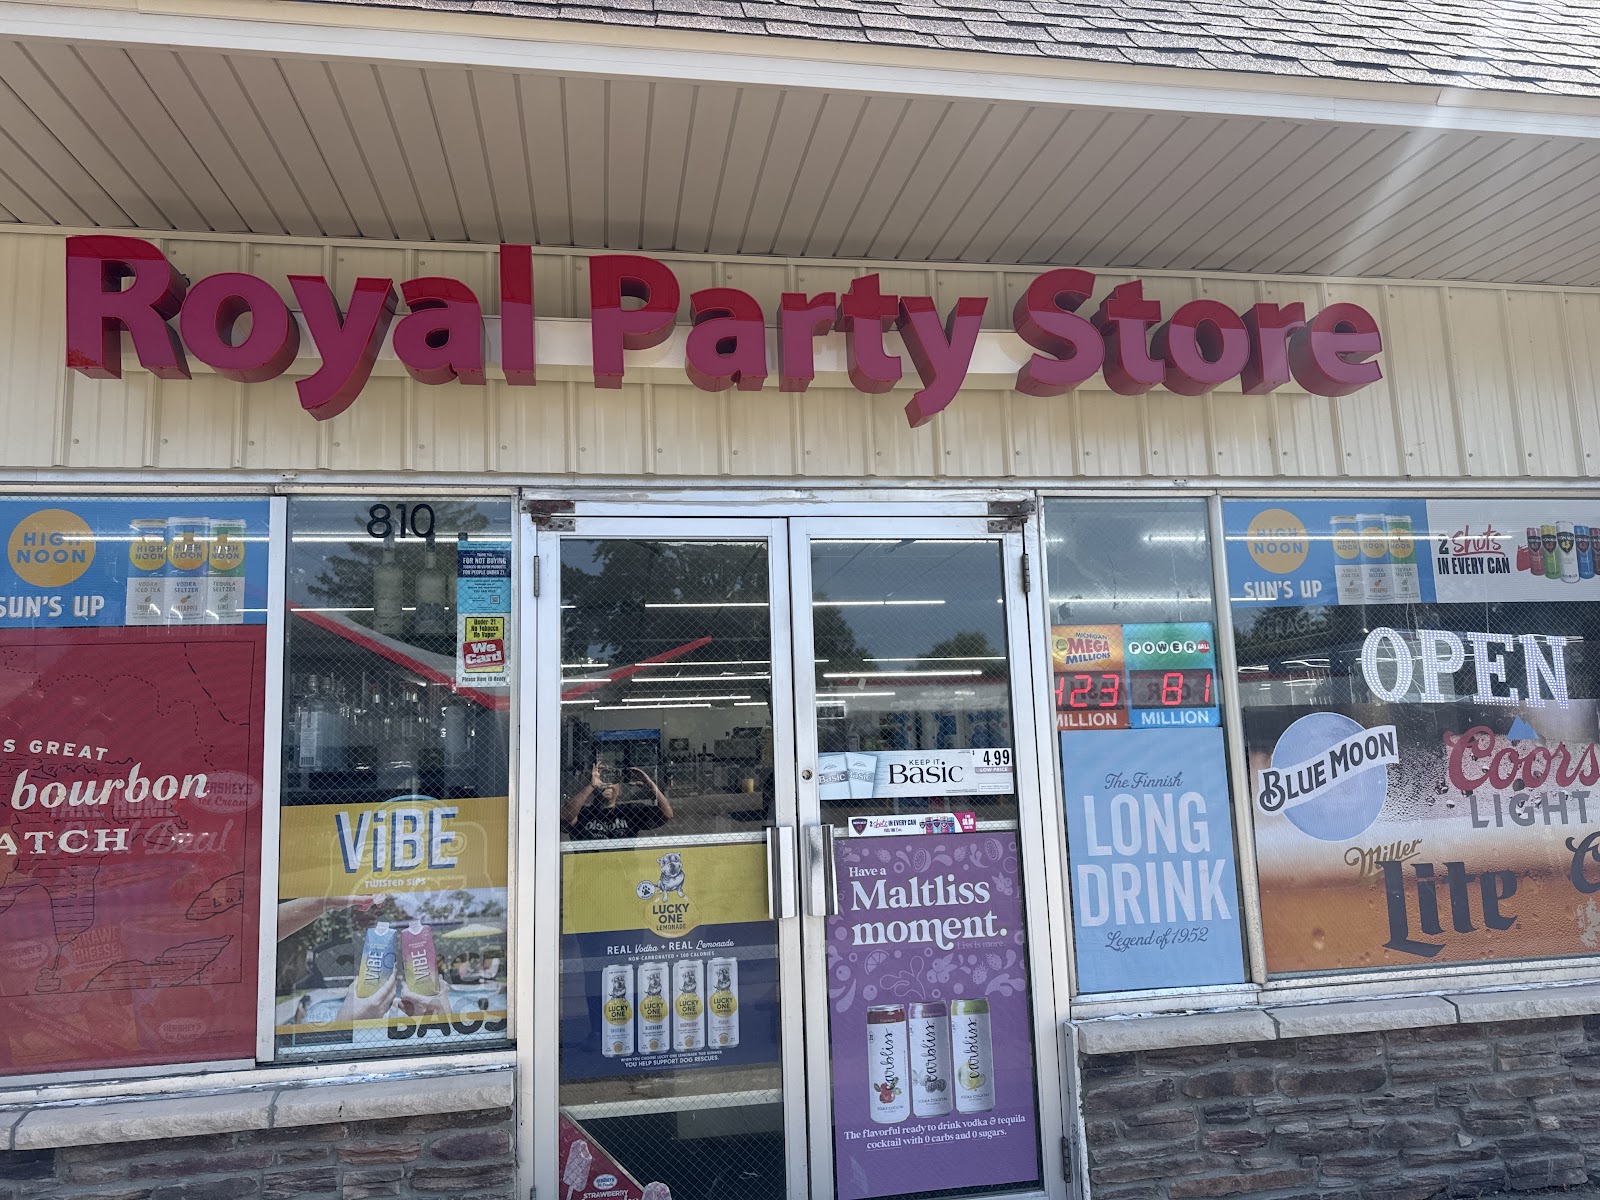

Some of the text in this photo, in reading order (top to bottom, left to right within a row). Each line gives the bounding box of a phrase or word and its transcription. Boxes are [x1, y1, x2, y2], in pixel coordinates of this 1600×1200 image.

[65, 235, 1383, 429] Royal Party Store
[366, 503, 435, 539] 810
[23, 532, 81, 546] HIGH
[1438, 533, 1450, 555] 2
[17, 549, 86, 563] NOON
[136, 545, 163, 553] HIGH
[1254, 542, 1304, 555] NOON
[462, 557, 507, 565] FOR NOT BUYING
[1437, 557, 1511, 575] IN EVERY CAN
[1243, 579, 1323, 599] SUN'S UP
[73, 594, 105, 617] UP
[1075, 632, 1108, 640] MICHIGAN
[470, 642, 497, 654] We
[1067, 638, 1111, 655] MEGA
[1129, 641, 1197, 654] POWER
[465, 651, 503, 665] Card
[1065, 652, 1111, 665] MILLIONS
[1360, 626, 1569, 710] OPEN
[1161, 672, 1211, 706] 81
[1141, 710, 1210, 726] MILLION
[29, 739, 109, 761] GREAT
[983, 749, 1010, 766] 4.99
[1443, 725, 1600, 791] Coors
[908, 758, 931, 766] KEEP
[819, 773, 846, 784] Basic
[888, 761, 964, 785] Basic
[1259, 731, 1397, 812] BLUE MOON
[10, 762, 211, 811] bourbon
[205, 780, 254, 797] ERSHEY'S
[1104, 771, 1184, 790] The Finnish
[1470, 789, 1591, 828] LIGHT
[893, 819, 907, 827] EVERY
[1083, 791, 1211, 857] LONG
[1343, 838, 1423, 884] Miller
[848, 867, 887, 877] Have a
[364, 879, 405, 889] TWISTED
[851, 874, 991, 911] Maltliss
[1077, 859, 1233, 928] DRINK
[652, 903, 690, 915] LUCKY
[1375, 860, 1518, 958] Lite
[656, 923, 687, 931] LEMONADE
[658, 913, 684, 924] ONE
[851, 910, 1008, 950] moment.
[607, 945, 632, 955] REAL
[634, 944, 659, 954] Vodka
[668, 941, 693, 951] REAL
[695, 938, 735, 950] Lemonade
[956, 941, 972, 949] Liss
[973, 941, 981, 949] is
[1104, 926, 1209, 953] Legend of 1952
[628, 953, 675, 961] NON-CARBONATED
[921, 1020, 938, 1083] carbliss
[962, 1017, 980, 1079] carbliss
[653, 1058, 679, 1066] SUPPORT
[694, 1054, 720, 1062] RESCUES.
[843, 1114, 1026, 1140] The flavorful ready to drink vodka & tequila
[866, 1138, 902, 1149] cocktail
[902, 1136, 924, 1145] with
[925, 1135, 931, 1143] 0
[931, 1133, 954, 1143] carbs
[955, 1131, 971, 1140] and
[978, 1129, 1008, 1140] sugars.
[583, 1189, 629, 1199] STRAWBERRY
